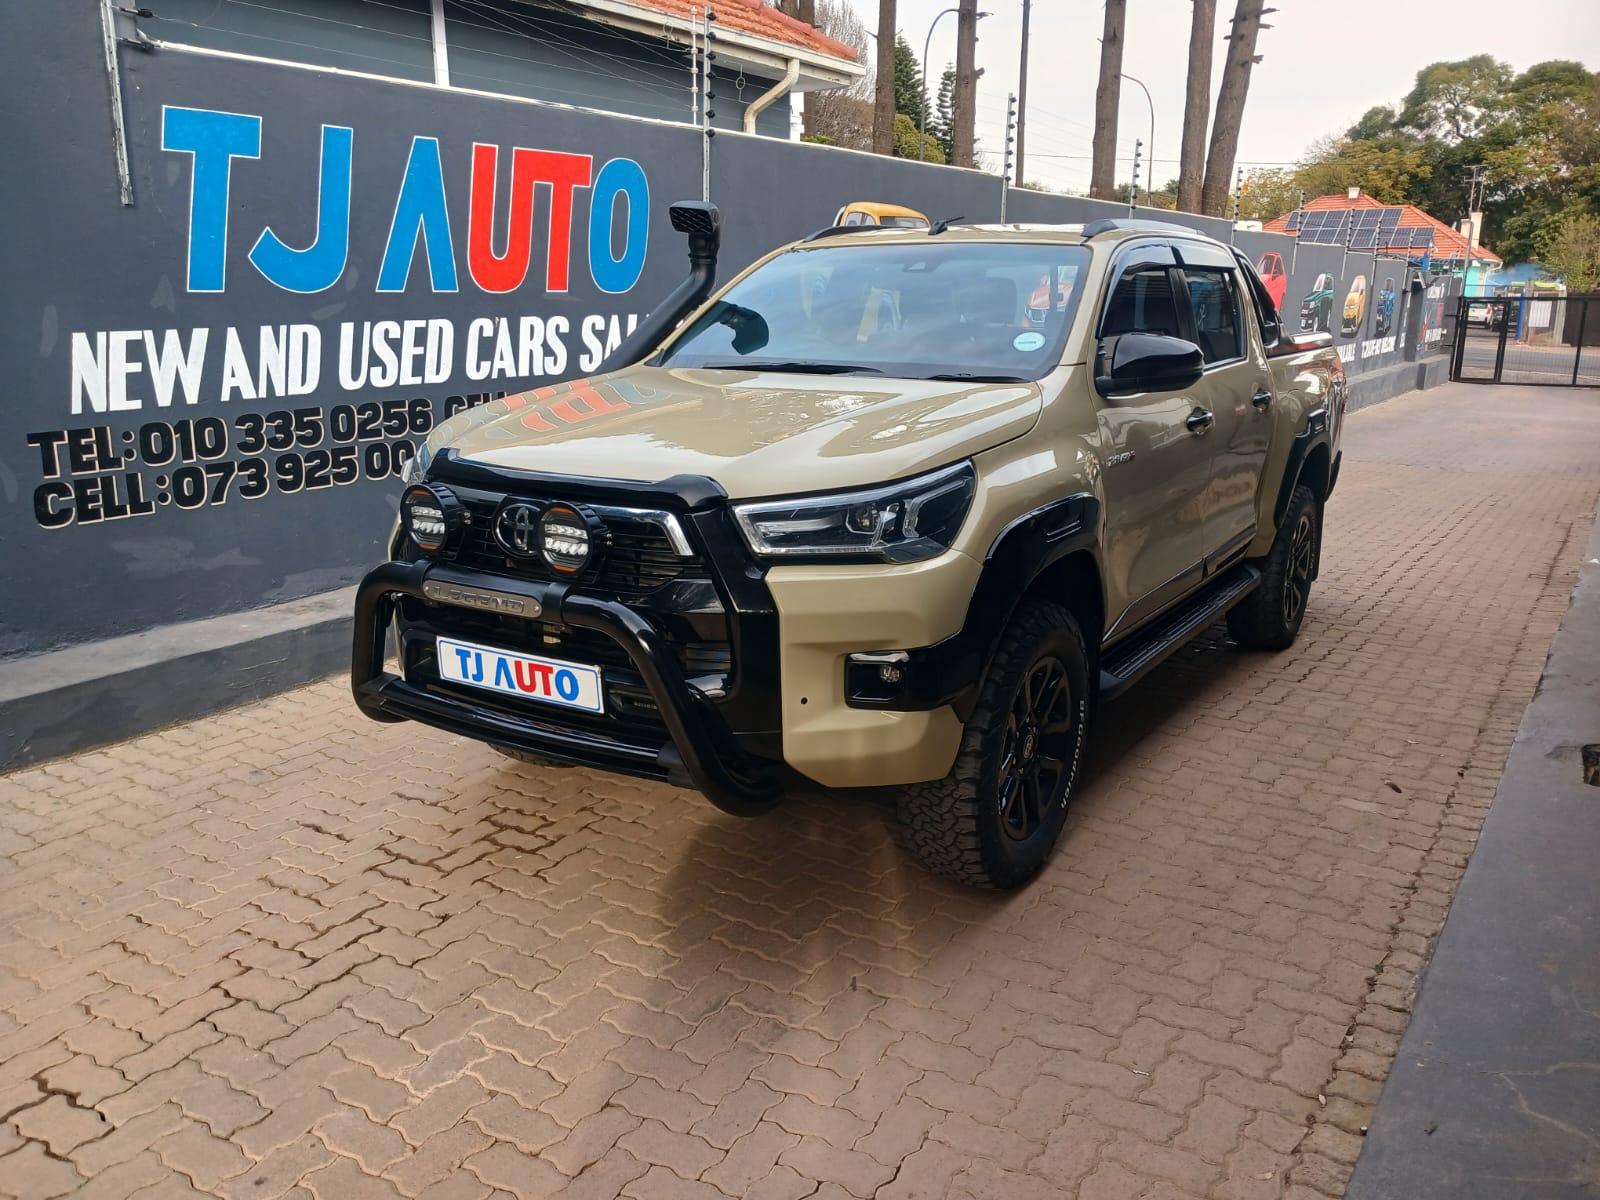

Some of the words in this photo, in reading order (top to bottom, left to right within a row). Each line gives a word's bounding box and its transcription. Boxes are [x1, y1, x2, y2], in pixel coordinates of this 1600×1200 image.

[161, 104, 354, 294] TJ
[375, 135, 650, 294] AUTO
[71, 328, 209, 414] NEW
[221, 323, 322, 402] AND
[338, 318, 454, 390] USED
[465, 315, 569, 381] CARS
[236, 409, 324, 456] 335
[331, 398, 434, 444] 0256
[277, 447, 358, 494] 925
[455, 648, 484, 683] TJ
[494, 656, 580, 702] AUTO
